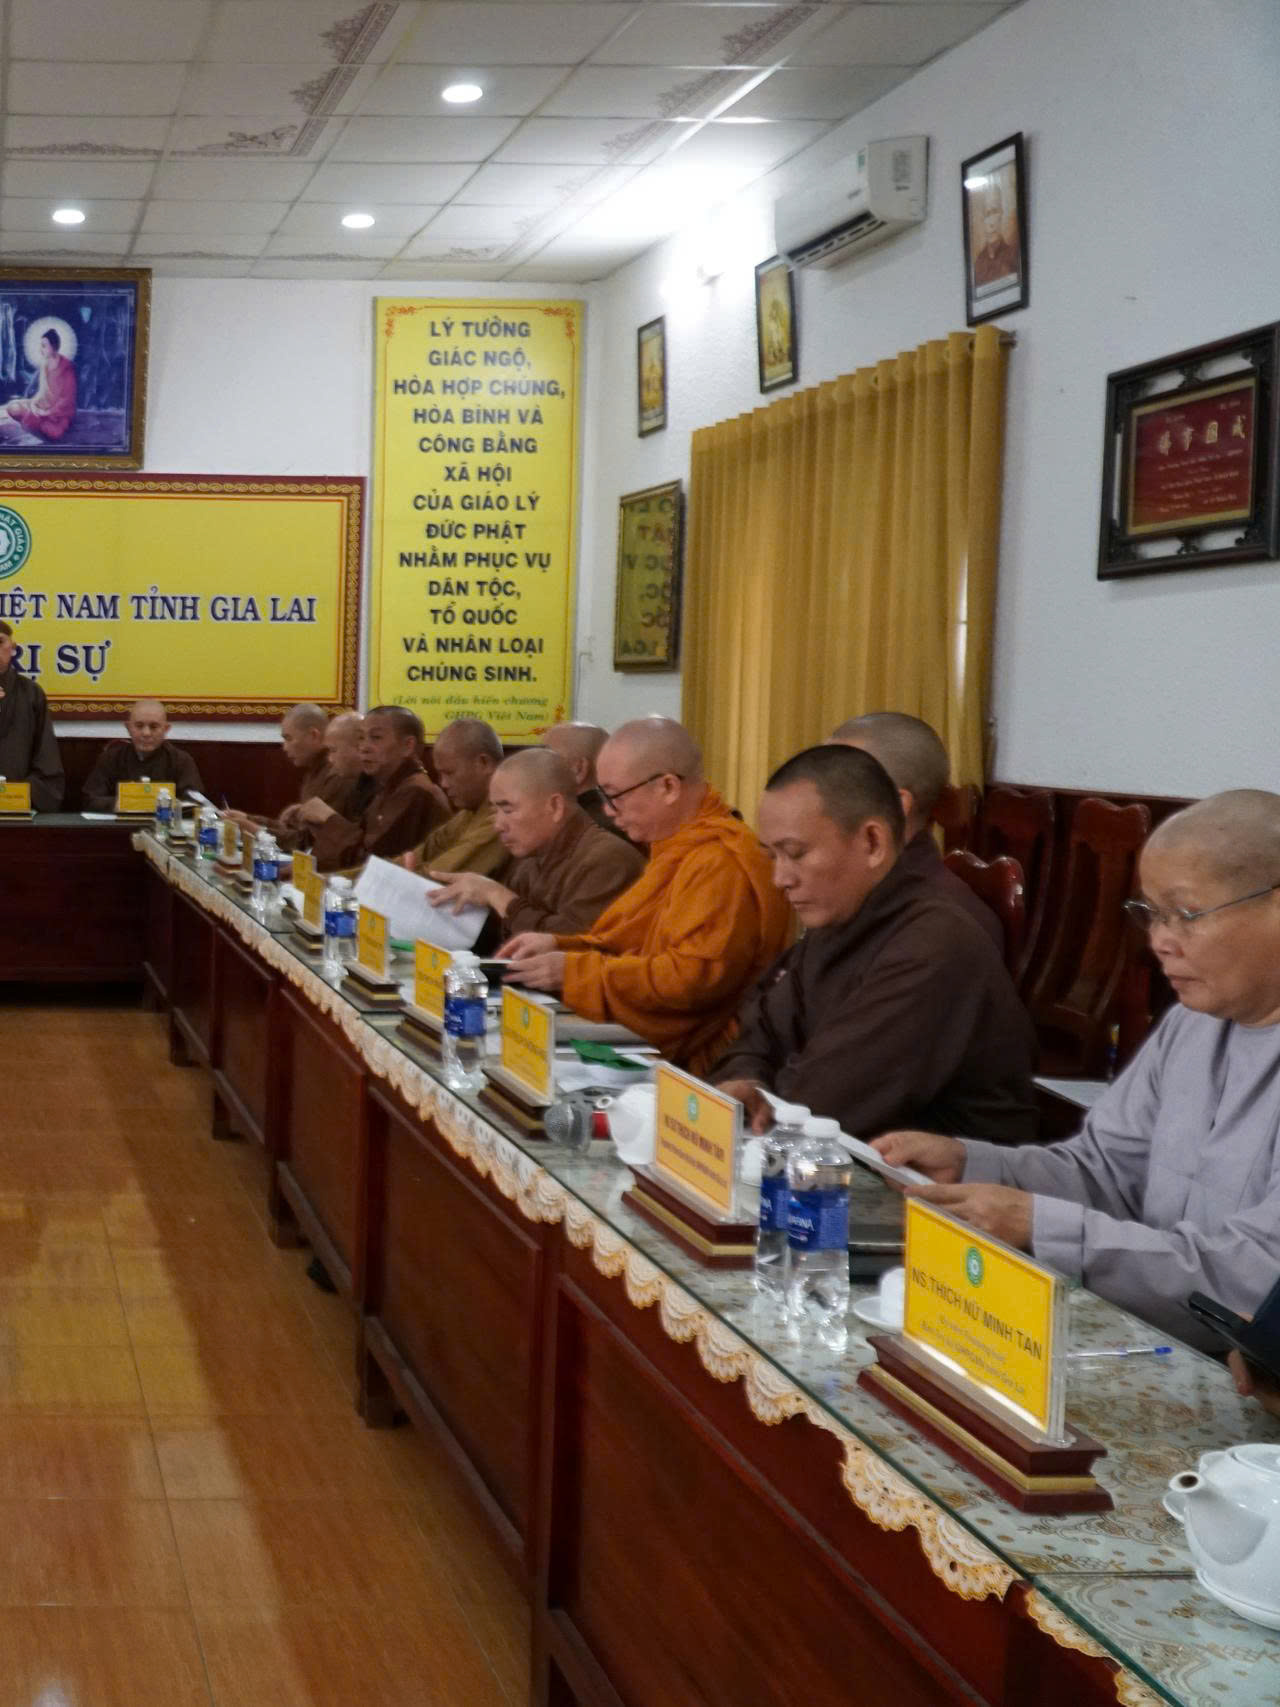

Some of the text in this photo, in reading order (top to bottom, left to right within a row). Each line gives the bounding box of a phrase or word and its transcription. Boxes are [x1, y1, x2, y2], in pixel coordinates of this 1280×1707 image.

[430, 315, 531, 338] LÝ TƯỞNG
[428, 346, 531, 370] GIÁC NGỘ,
[393, 375, 568, 400] HÒA HỢP CHÚNG,
[414, 404, 543, 424] HÒA BÌNH VÀ
[419, 431, 537, 454] CÔNG BẰNG
[444, 462, 511, 486] XÃ HỘI
[413, 489, 540, 511] CỦA GIÁO LÝ
[425, 520, 526, 544] ĐỨC PHẬT
[400, 545, 551, 572] NHẰM PHỤC VỤ
[428, 577, 521, 600] DÂN TỘC,
[57, 594, 120, 619] NAM
[131, 586, 201, 620] TỈNH
[211, 598, 262, 622] GIA
[269, 598, 317, 623] LAI
[430, 598, 519, 625] TỔ QUỐC
[403, 633, 543, 658] VÀ NHÂN LOẠI
[57, 639, 112, 682] SỰ
[407, 662, 536, 682] CHÚNG SINH.
